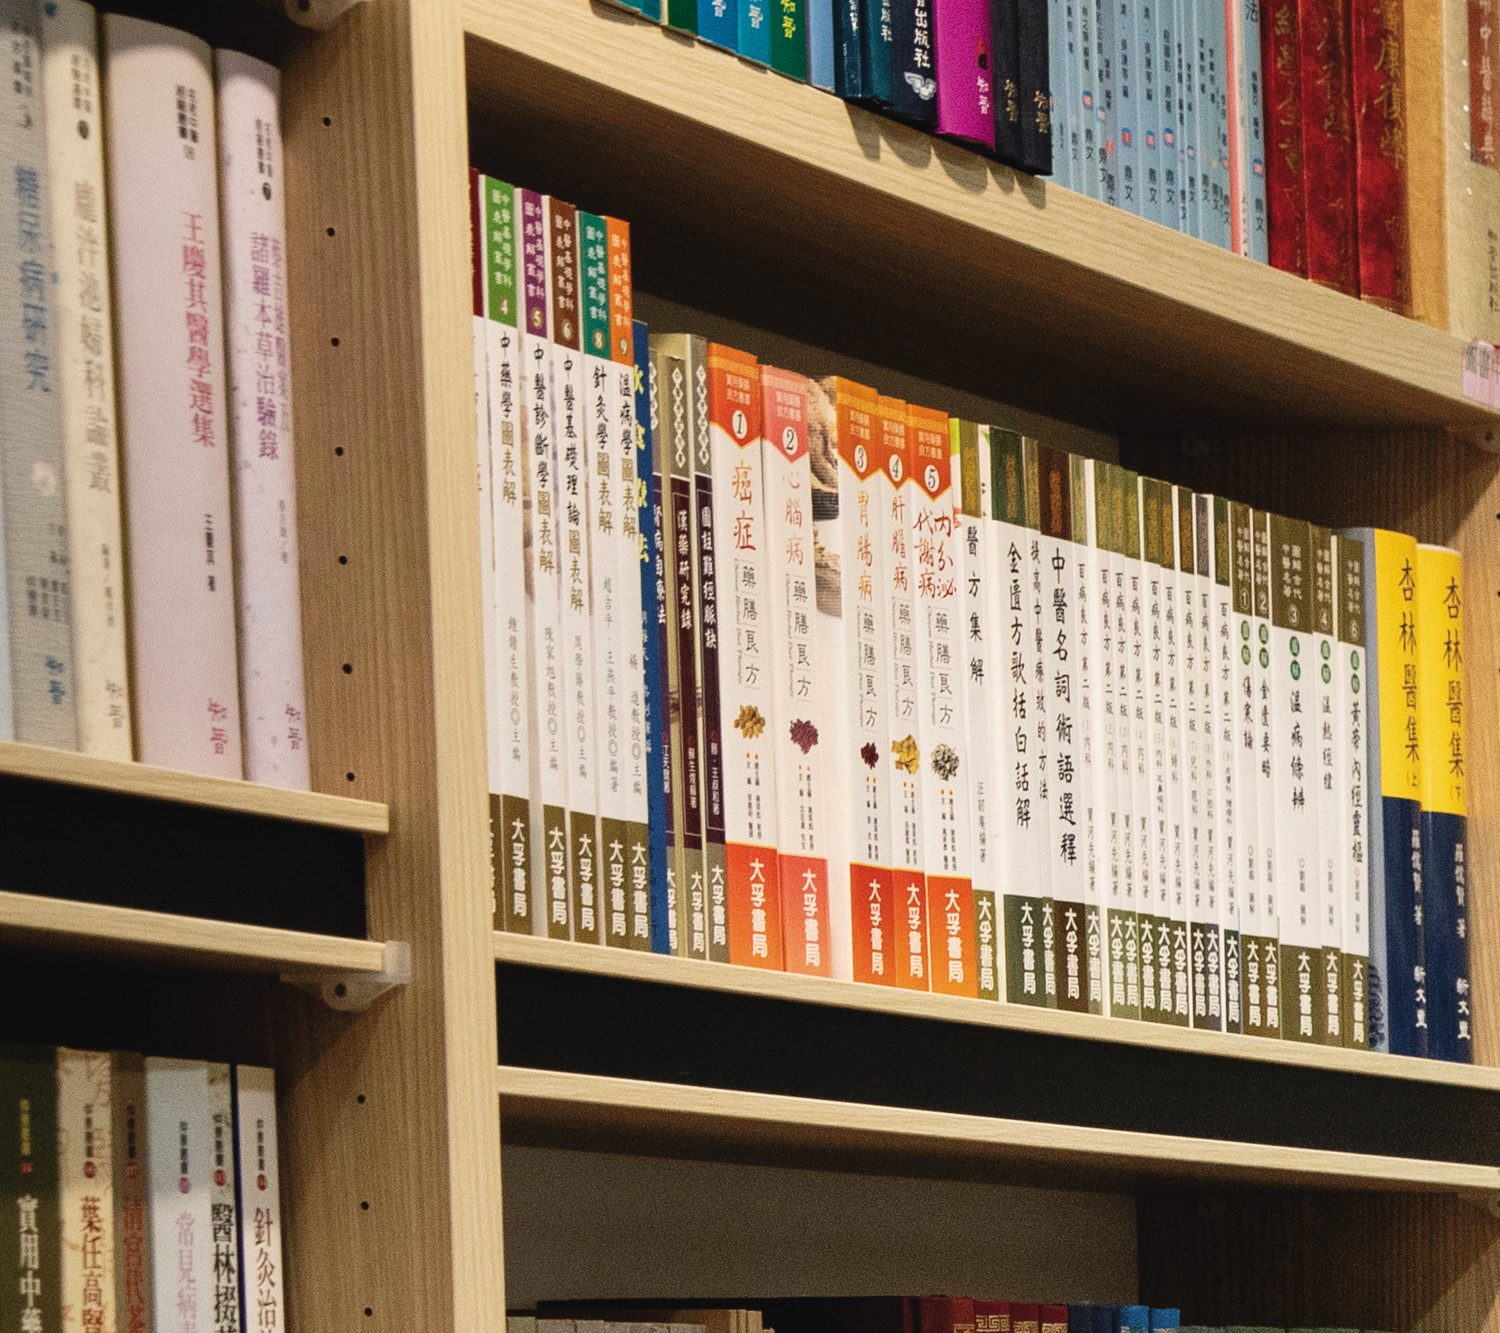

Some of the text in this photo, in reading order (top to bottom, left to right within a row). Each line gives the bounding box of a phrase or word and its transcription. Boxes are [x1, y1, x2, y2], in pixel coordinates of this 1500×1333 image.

[532, 342, 555, 577] 中醫診斷學圖表解
[563, 354, 585, 616] 中醫基礎理論圖表解
[592, 365, 613, 535] 針灸學圖表解
[619, 371, 638, 543] 溫病學圖表解
[731, 459, 756, 551] 癌症
[857, 490, 873, 600] 胃腸病
[966, 525, 985, 686] 醫方集解
[1006, 542, 1032, 830] 金匱方歌括白話解
[511, 817, 527, 918] 大孚書局
[549, 826, 568, 927] 大孚書局
[579, 834, 595, 933] 大孚書局
[609, 839, 627, 937] 大孚書局
[750, 858, 768, 959] 大孚書局
[802, 868, 821, 968] 大孚書局
[945, 889, 965, 984] 大孚書局
